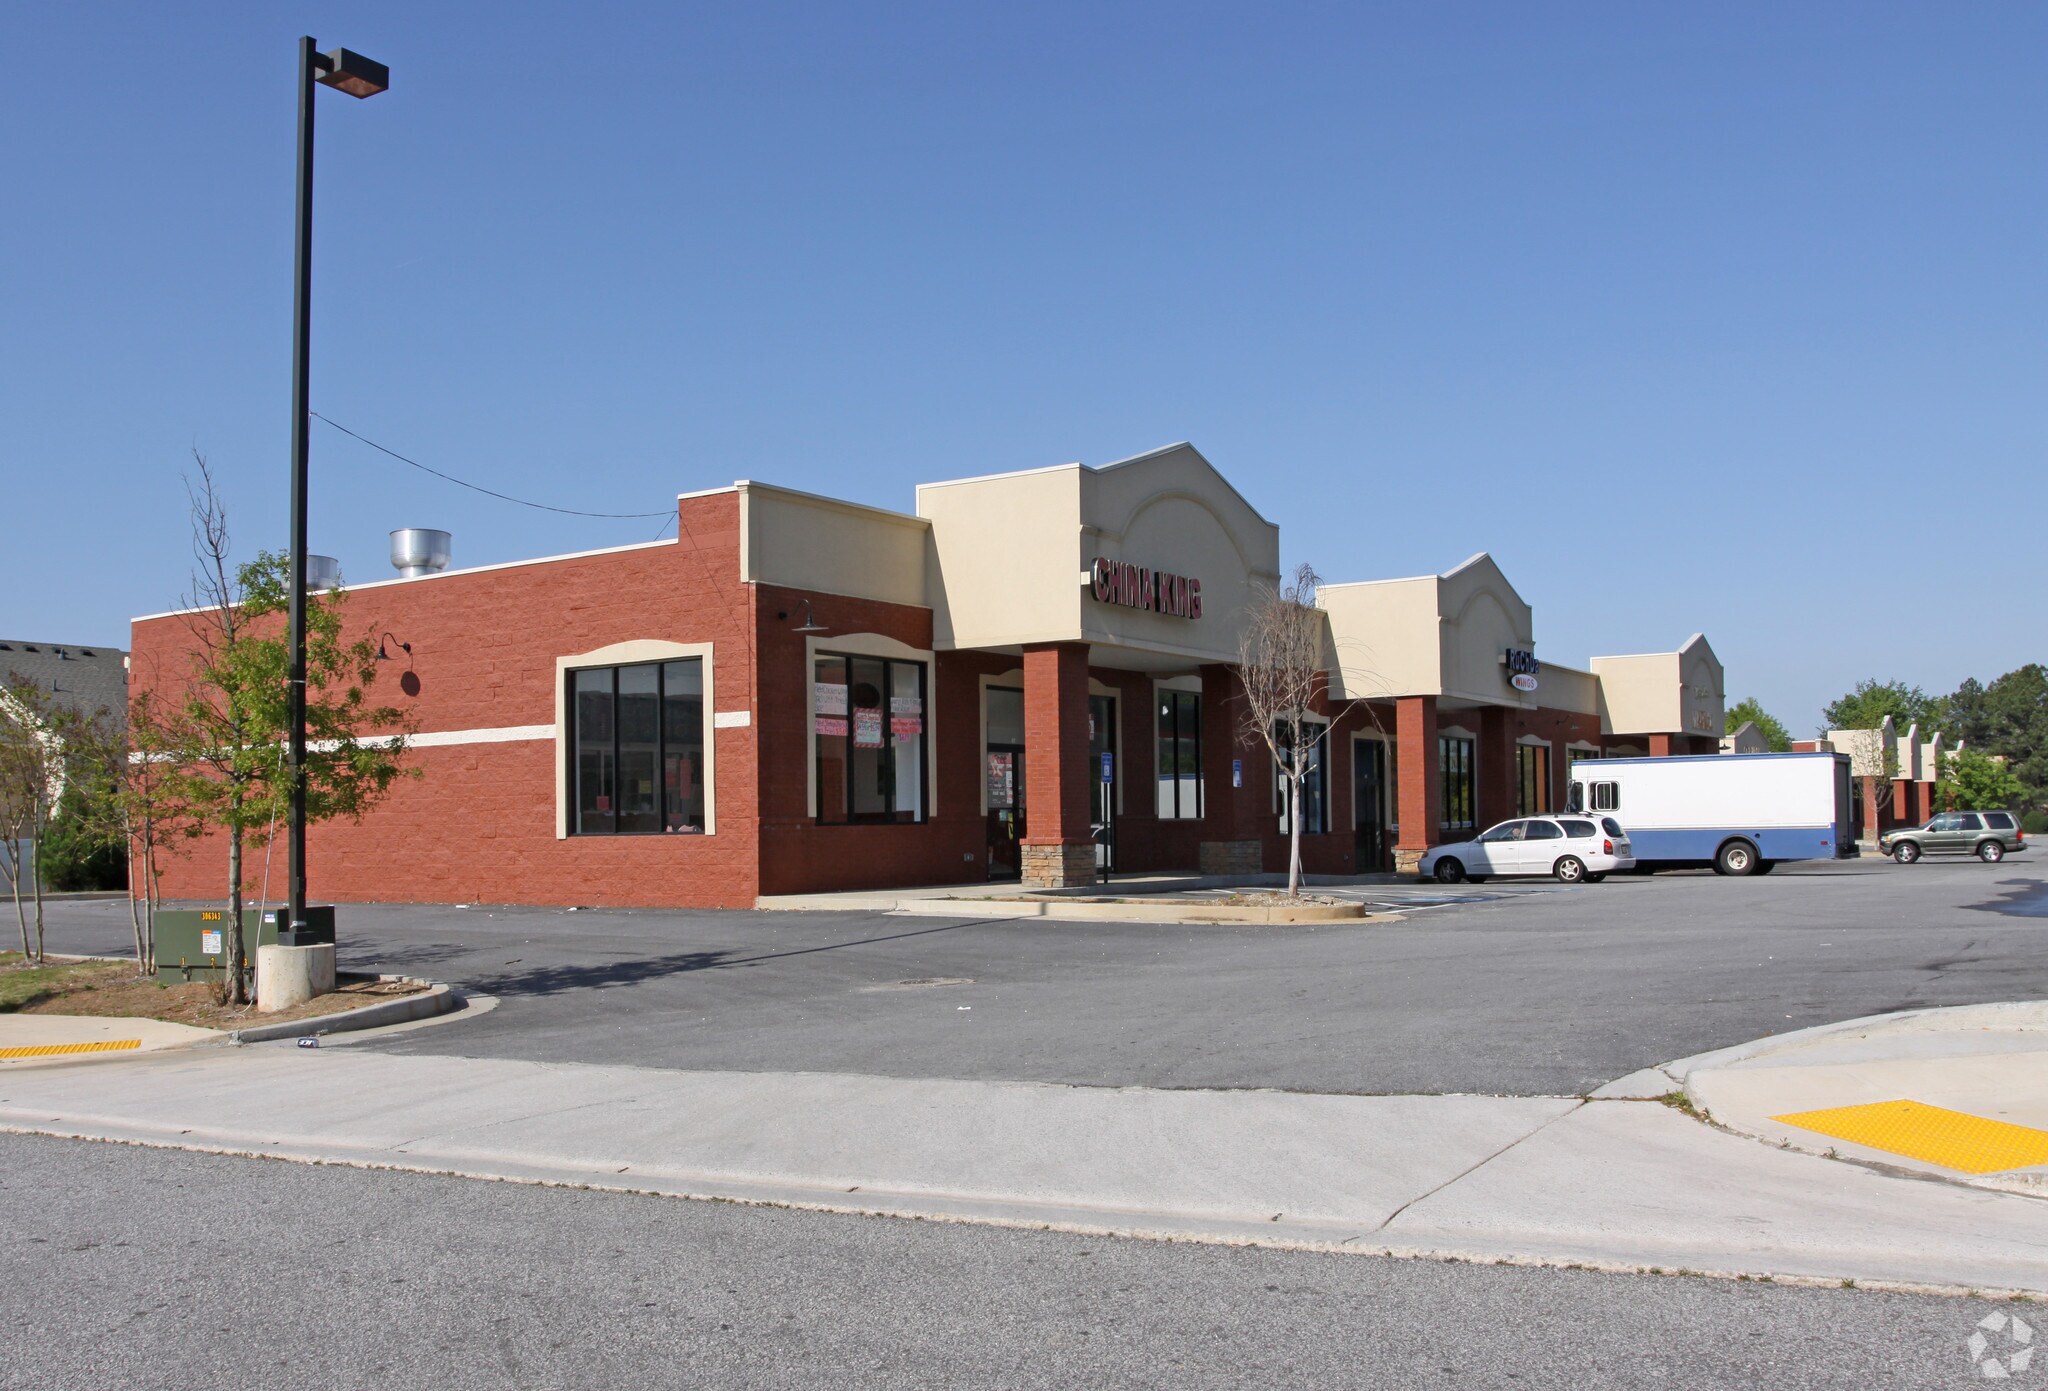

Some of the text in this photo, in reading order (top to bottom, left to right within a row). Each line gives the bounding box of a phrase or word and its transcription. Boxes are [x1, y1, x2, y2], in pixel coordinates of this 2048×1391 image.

[1090, 557, 1203, 619] CHINA KING
[1515, 677, 1535, 688] WINGS
